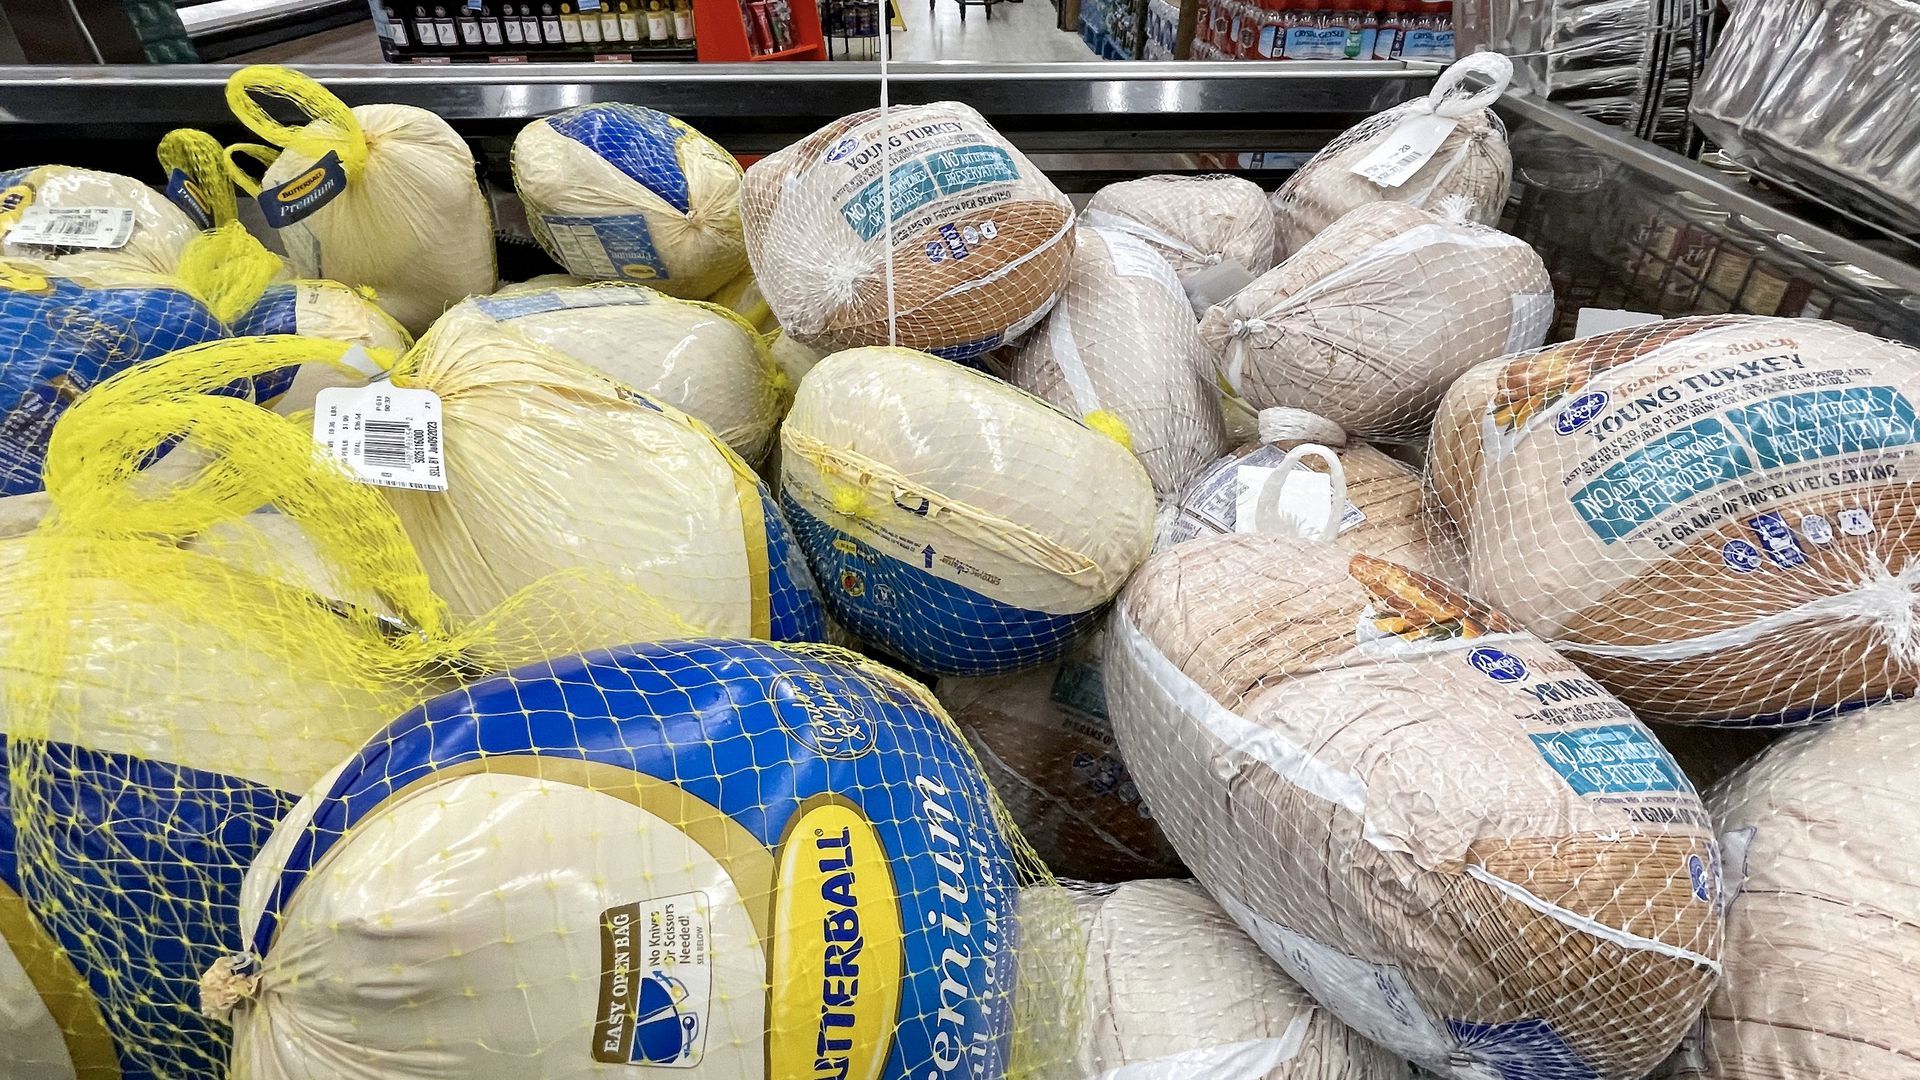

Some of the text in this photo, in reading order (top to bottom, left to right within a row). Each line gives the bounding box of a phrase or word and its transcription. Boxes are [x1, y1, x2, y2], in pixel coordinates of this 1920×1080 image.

[901, 122, 963, 145] TURKEY
[941, 152, 959, 169] NO
[280, 178, 335, 217] Premium
[843, 202, 867, 225] NO
[1616, 360, 1697, 399] Tender
[1562, 394, 1602, 428] Kroger
[1585, 353, 1807, 443] YOUNG TURKEY
[1754, 399, 1796, 429] NO
[1612, 448, 1622, 458] &
[1622, 430, 1637, 442] TO
[1579, 432, 1732, 522] NO ADDED HORMONES
[1617, 457, 1724, 522] OR STEROIDS
[1672, 505, 1723, 541] GRAMS
[1723, 498, 1741, 516] OF
[1829, 463, 1899, 485] SERVING
[1476, 653, 1521, 678] Kroger
[1520, 677, 1595, 706] YOUNG
[1541, 741, 1578, 767] NO
[1582, 766, 1604, 786] OR
[648, 911, 662, 966] No Knives
[664, 903, 677, 947] Scissors
[677, 915, 692, 965] Needed!
[696, 926, 705, 951] BELOW
[914, 774, 971, 1080] emium
[814, 827, 864, 1080] UTTERBALL
[602, 913, 631, 1053] EASY OPEN BAG
